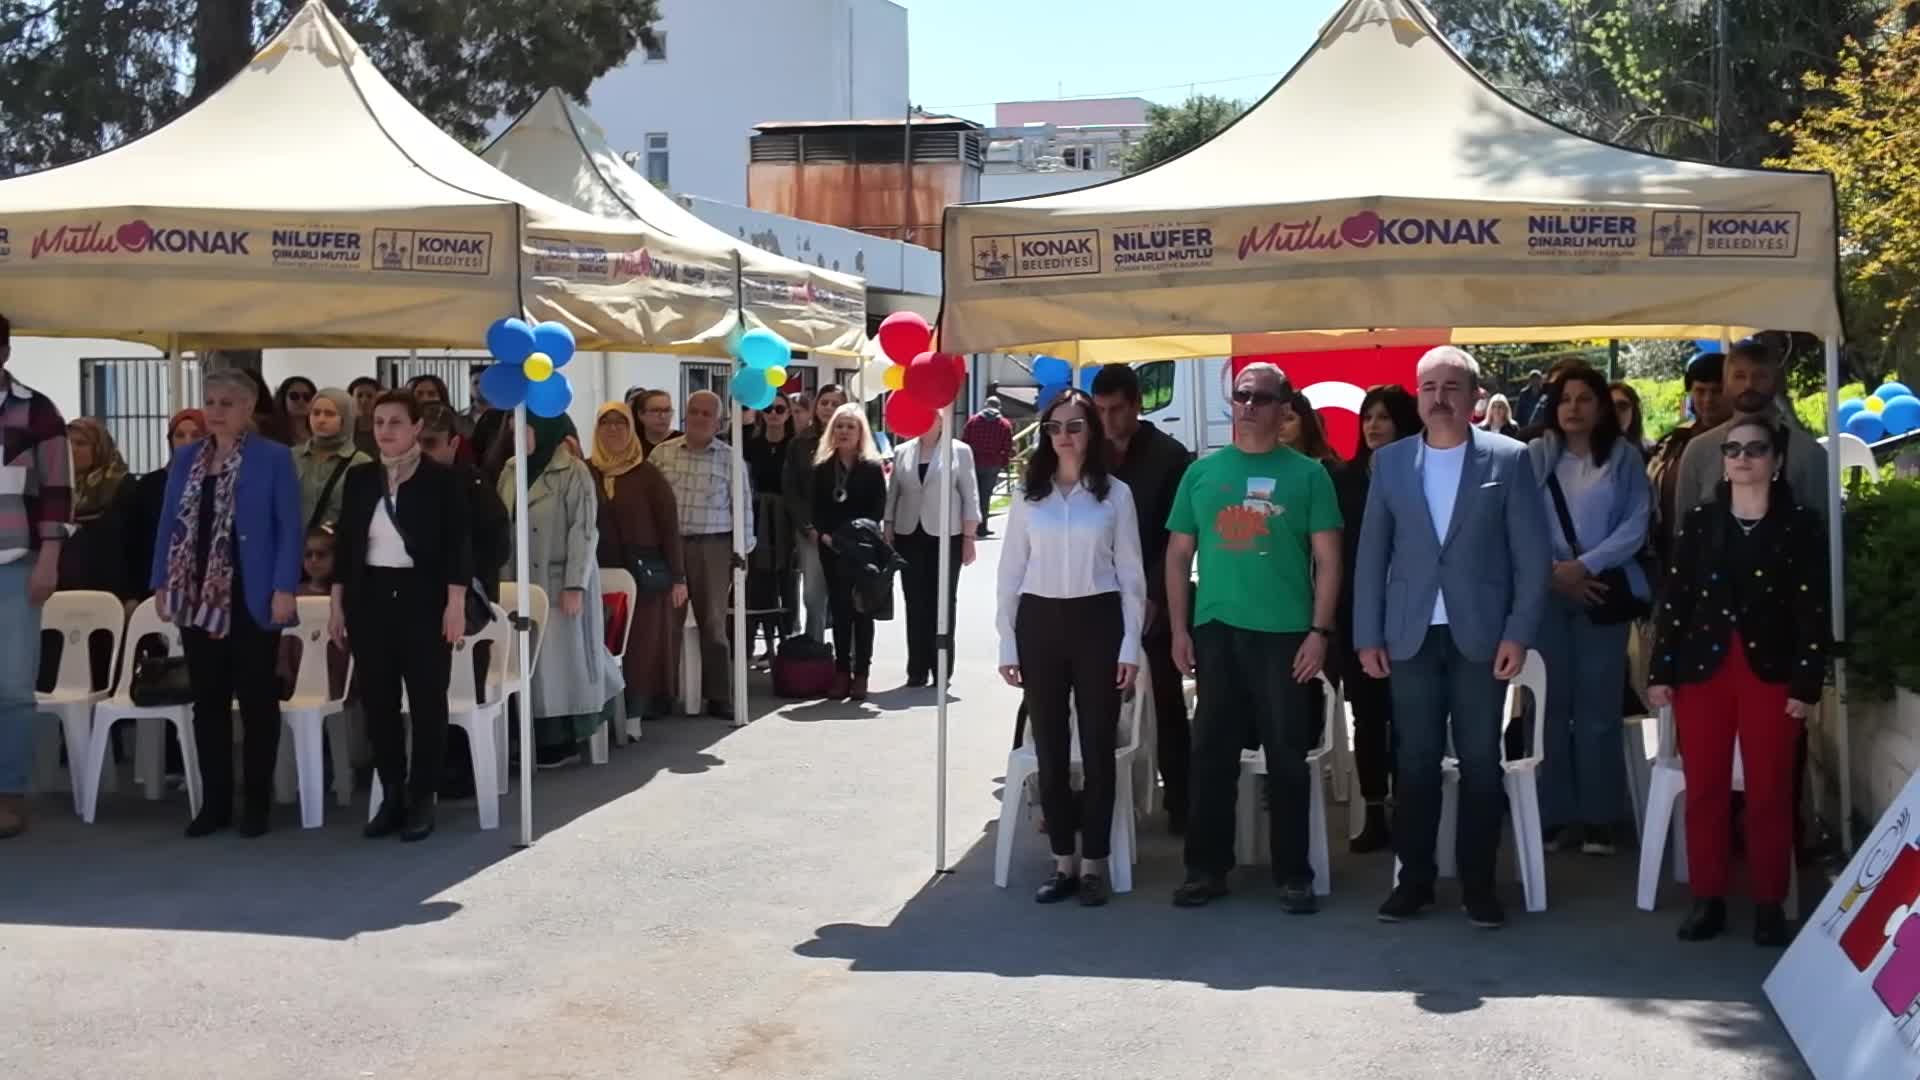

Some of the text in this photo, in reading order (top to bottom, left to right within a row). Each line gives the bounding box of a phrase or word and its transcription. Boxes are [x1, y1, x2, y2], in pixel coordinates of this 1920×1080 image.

[1707, 219, 1790, 235] KONAK
[32, 221, 118, 259] Mutlu
[149, 229, 249, 255] KONAK
[418, 237, 485, 254] KONAK
[1238, 215, 1502, 261] Mutlu KONAK
[1586, 236, 1637, 248] MUTLU
[1021, 237, 1092, 257] KONAK
[1167, 248, 1213, 261] MUTLU
[319, 251, 360, 262] MUTLU
